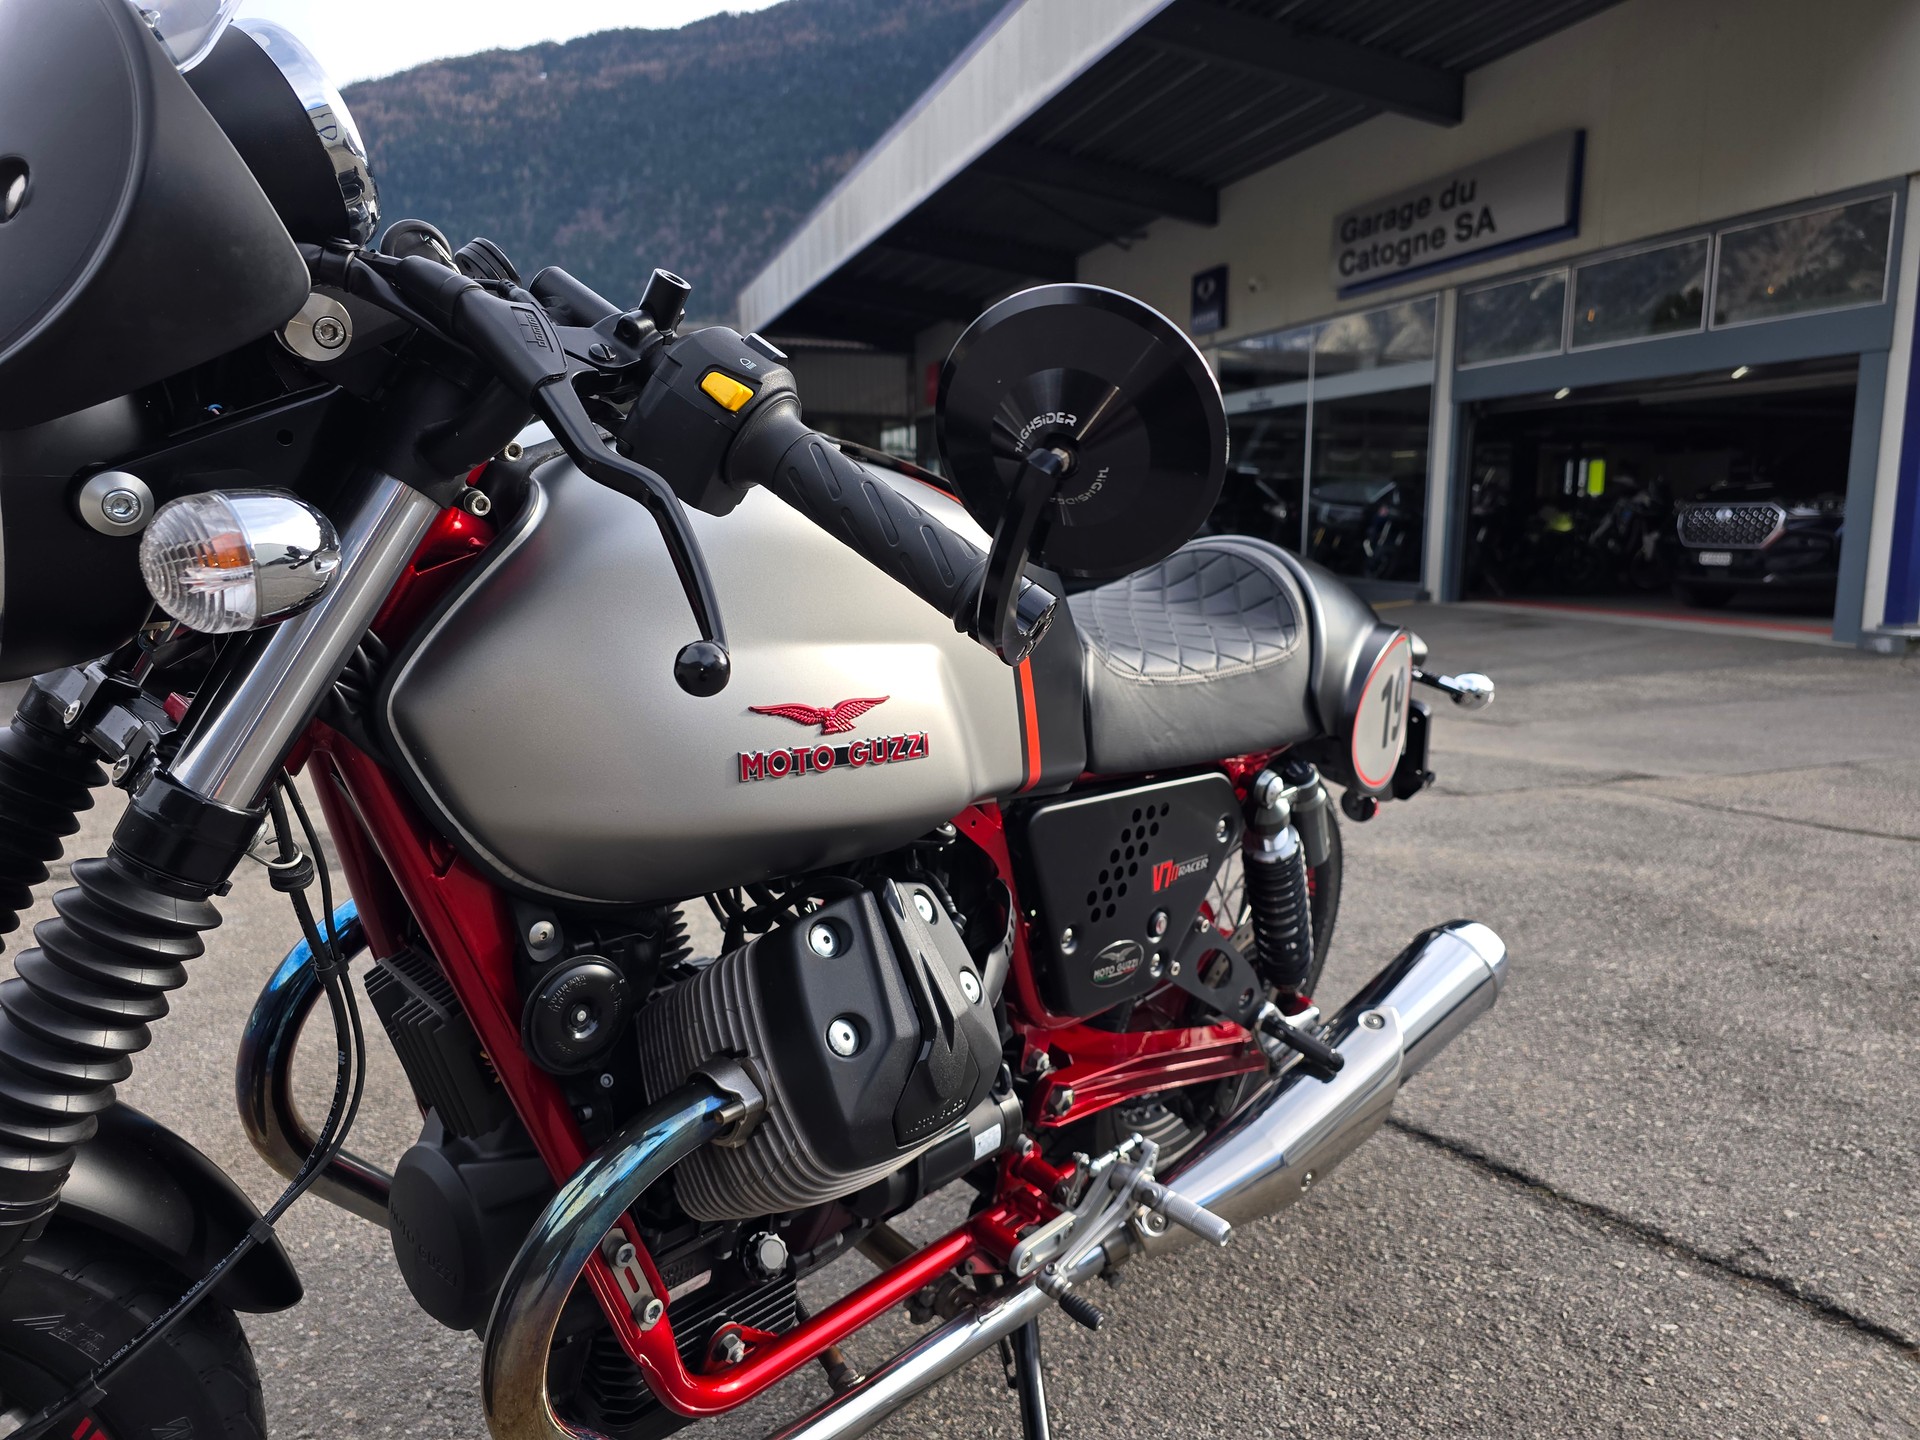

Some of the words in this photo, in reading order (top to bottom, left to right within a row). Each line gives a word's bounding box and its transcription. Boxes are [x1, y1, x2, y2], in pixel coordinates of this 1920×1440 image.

[1340, 195, 1431, 244] Garage
[1439, 178, 1477, 212] du
[1338, 226, 1446, 276] Catogne
[1455, 206, 1496, 243] SA
[1381, 666, 1405, 749] 19
[738, 743, 836, 783] MOTO
[848, 731, 930, 768] GUZZI
[1178, 858, 1209, 877] RACER
[1093, 965, 1115, 981] MOTO
[1117, 958, 1139, 973] GUZZI
